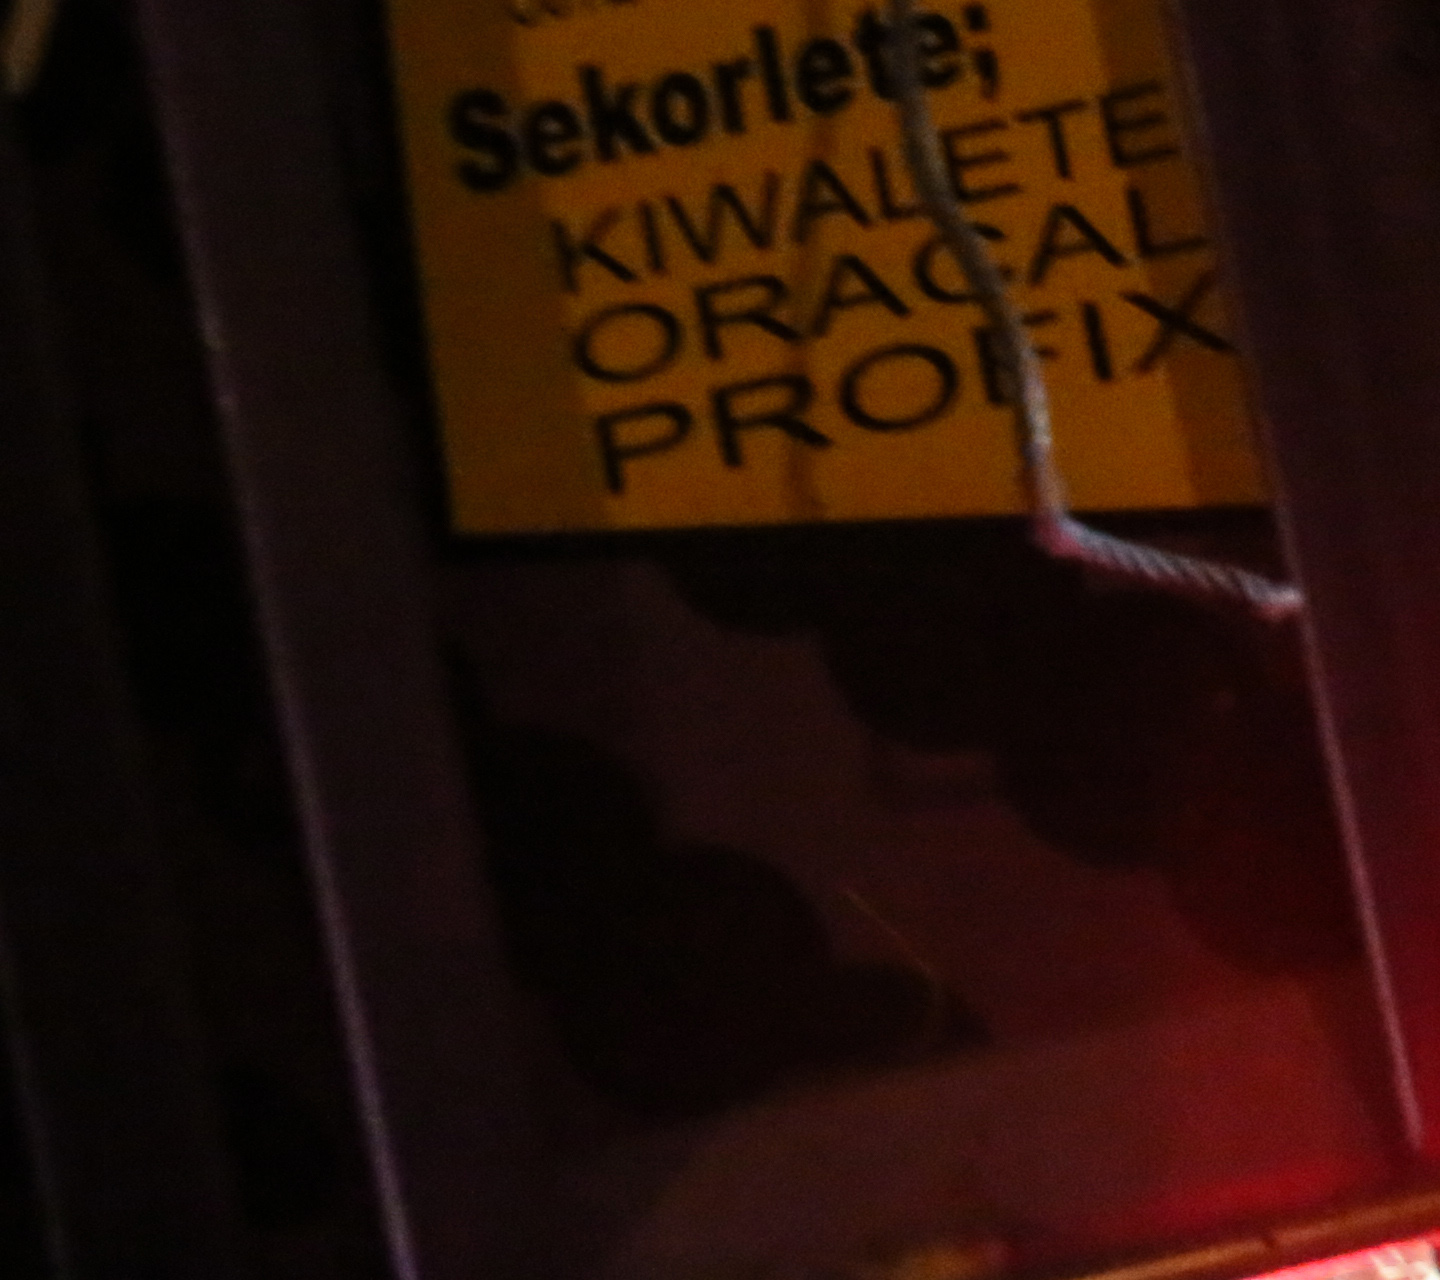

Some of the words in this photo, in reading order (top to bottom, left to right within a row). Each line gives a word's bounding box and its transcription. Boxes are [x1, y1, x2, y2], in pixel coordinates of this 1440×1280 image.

[552, 80, 1178, 292] KIWALETE
[573, 189, 1206, 380] ORACAL
[596, 271, 1232, 492] PROFIX
